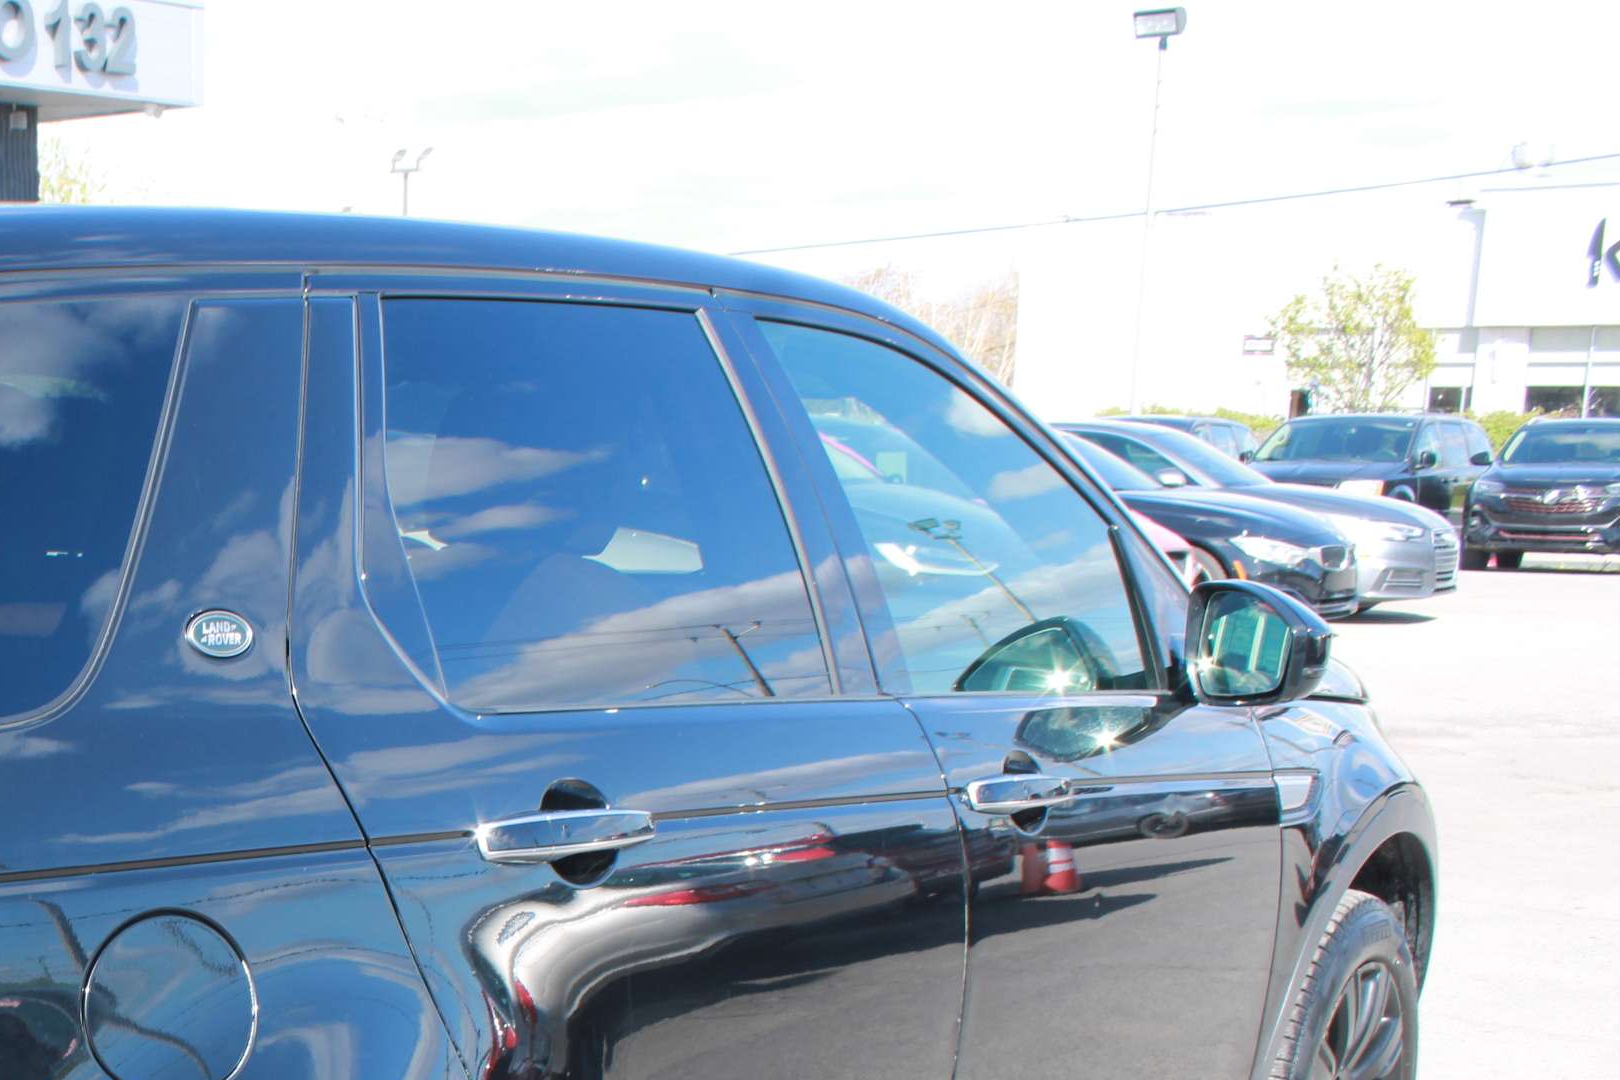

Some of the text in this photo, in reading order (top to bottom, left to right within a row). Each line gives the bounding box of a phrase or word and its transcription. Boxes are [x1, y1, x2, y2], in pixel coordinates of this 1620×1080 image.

[44, 0, 137, 76] 132
[202, 620, 232, 634] LAND
[207, 632, 242, 646] ROVER
